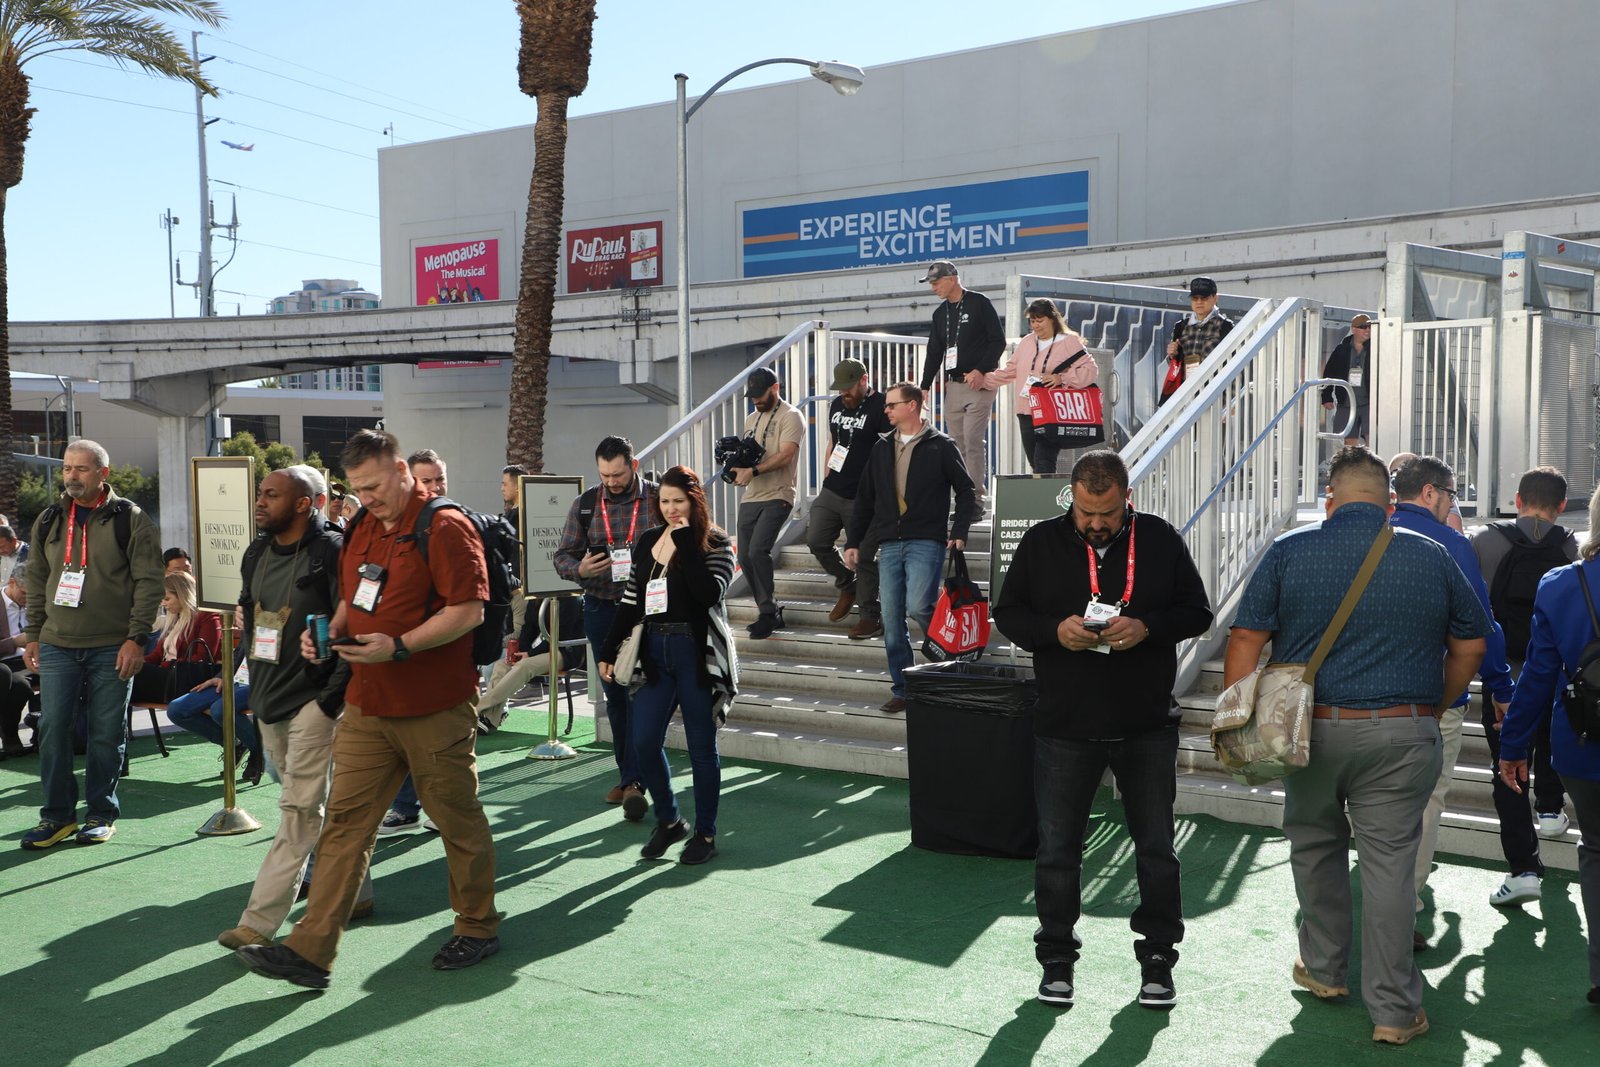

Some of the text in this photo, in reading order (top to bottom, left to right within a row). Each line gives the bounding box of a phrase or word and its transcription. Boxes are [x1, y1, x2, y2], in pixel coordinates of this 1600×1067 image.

[800, 203, 951, 241] EXPERIENCE
[859, 221, 1021, 259] EXCITEMENT
[424, 241, 486, 272] Menopause
[595, 254, 609, 262] DRAG
[611, 252, 625, 261] RACE
[441, 265, 486, 279] The Musical
[204, 523, 244, 535] DESIGNATED
[210, 539, 240, 551] SMOKING
[216, 553, 235, 566] AREA
